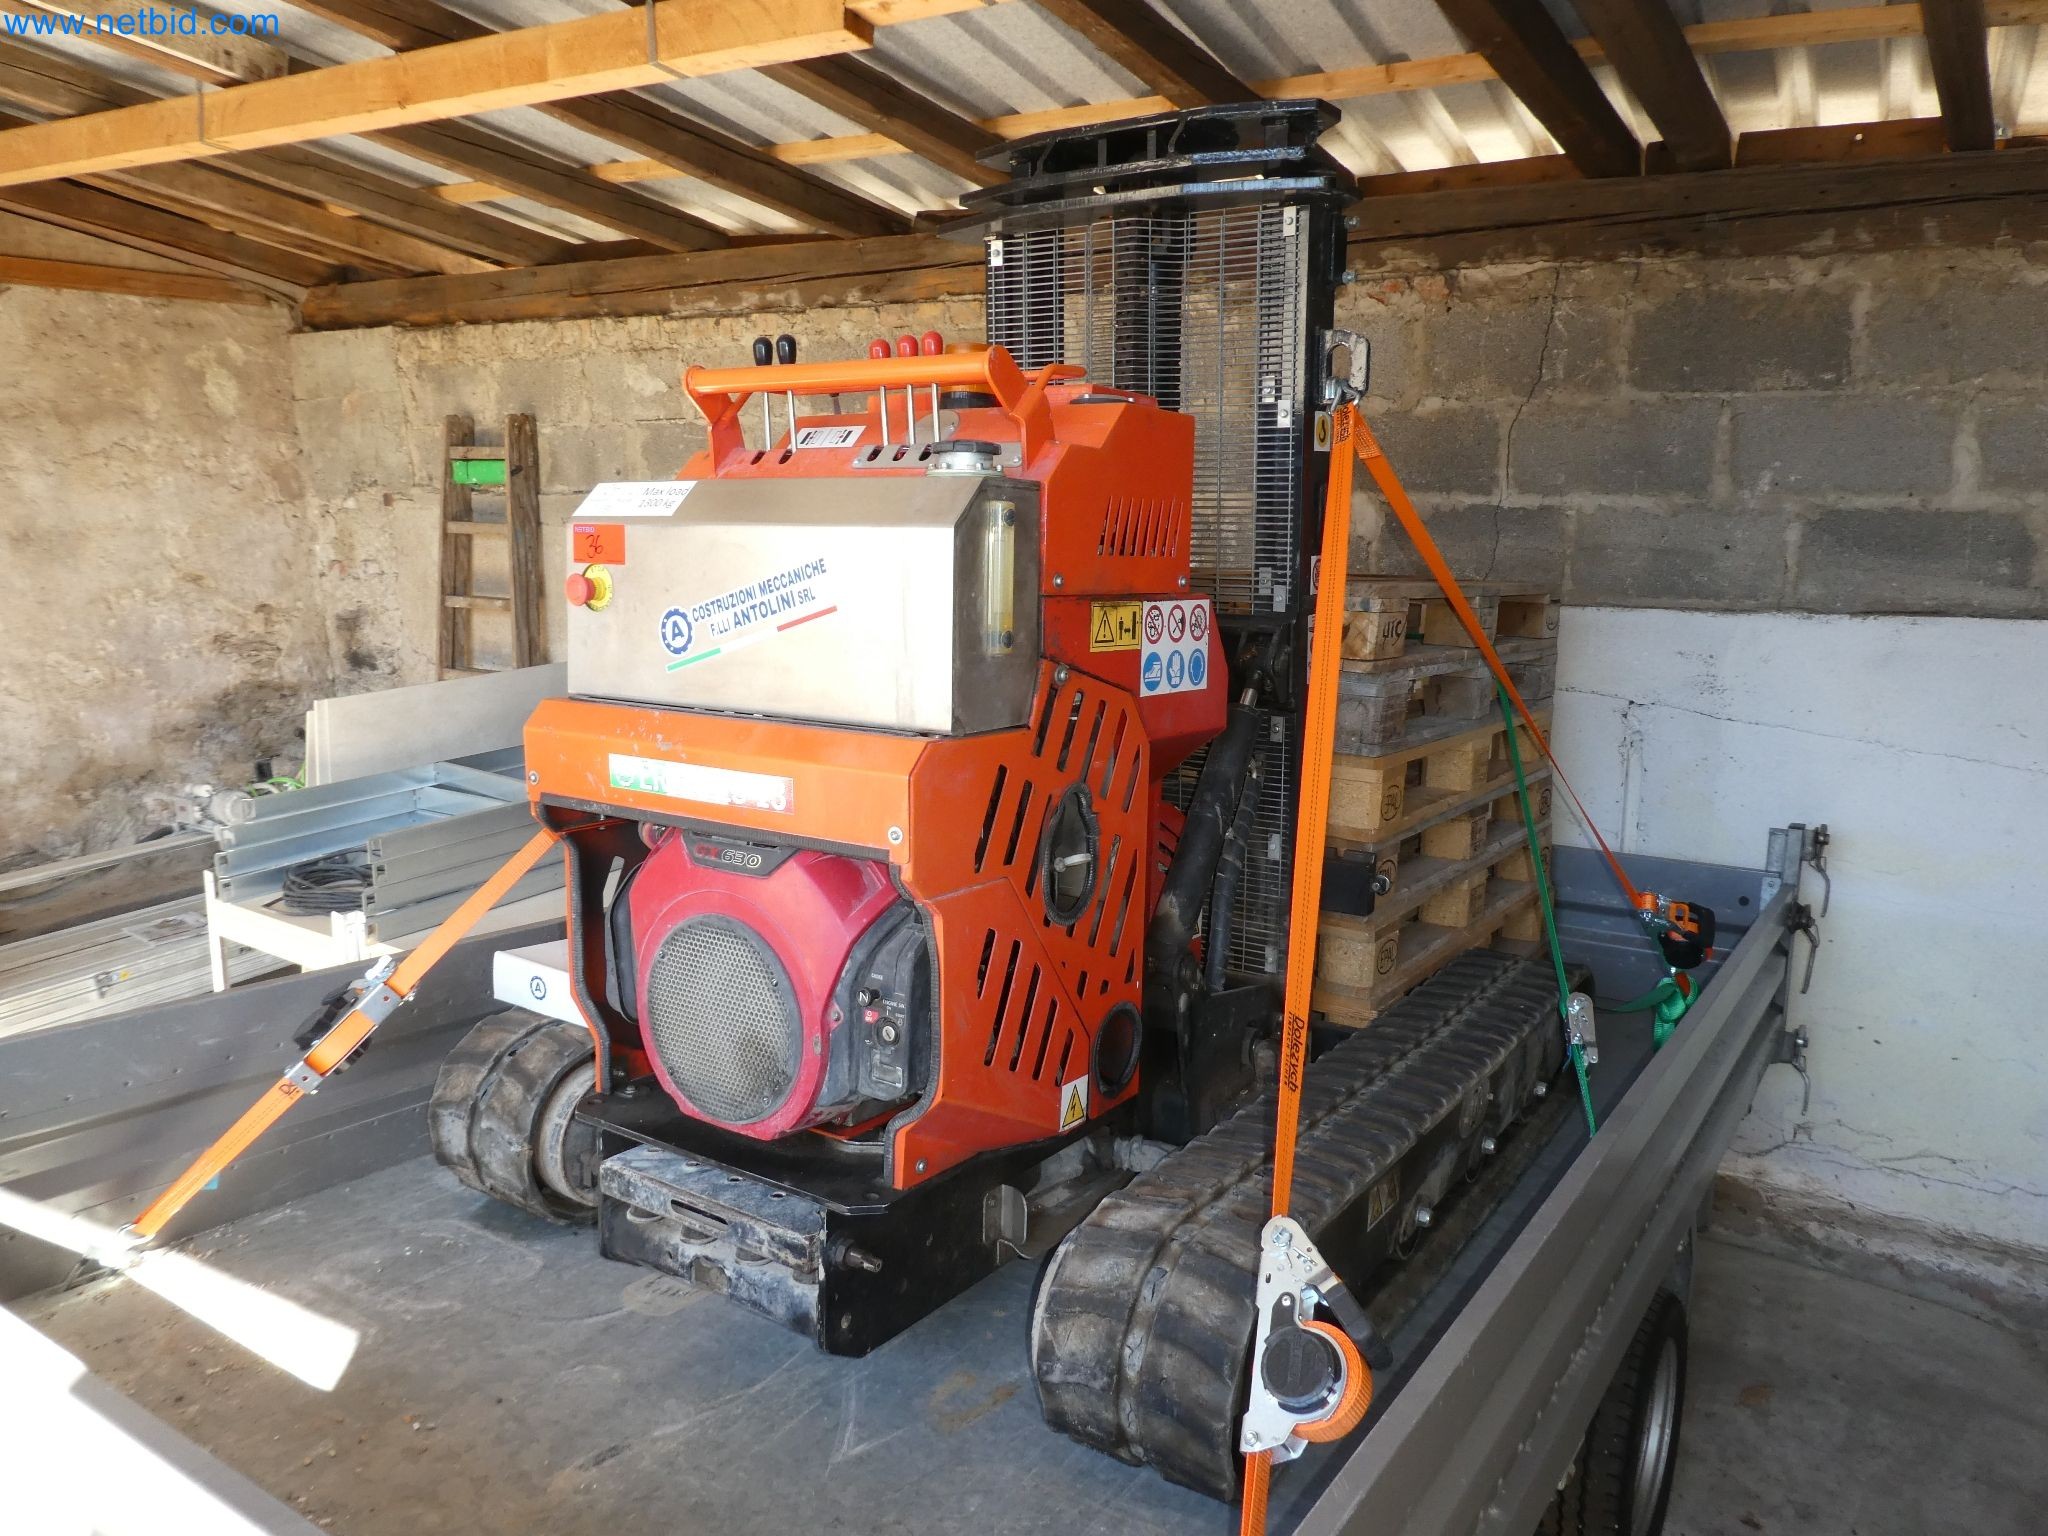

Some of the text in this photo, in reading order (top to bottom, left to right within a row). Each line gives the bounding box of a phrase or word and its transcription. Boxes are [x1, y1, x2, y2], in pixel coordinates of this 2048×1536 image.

[643, 486, 692, 496] Max load
[585, 534, 604, 559] 36
[692, 557, 827, 623] COSTRUZIONI MECCANICHE
[733, 590, 796, 629] ANTOLINI
[797, 586, 816, 605] SRL
[721, 848, 762, 868] 630
[1287, 1014, 1305, 1093] Dolezych
